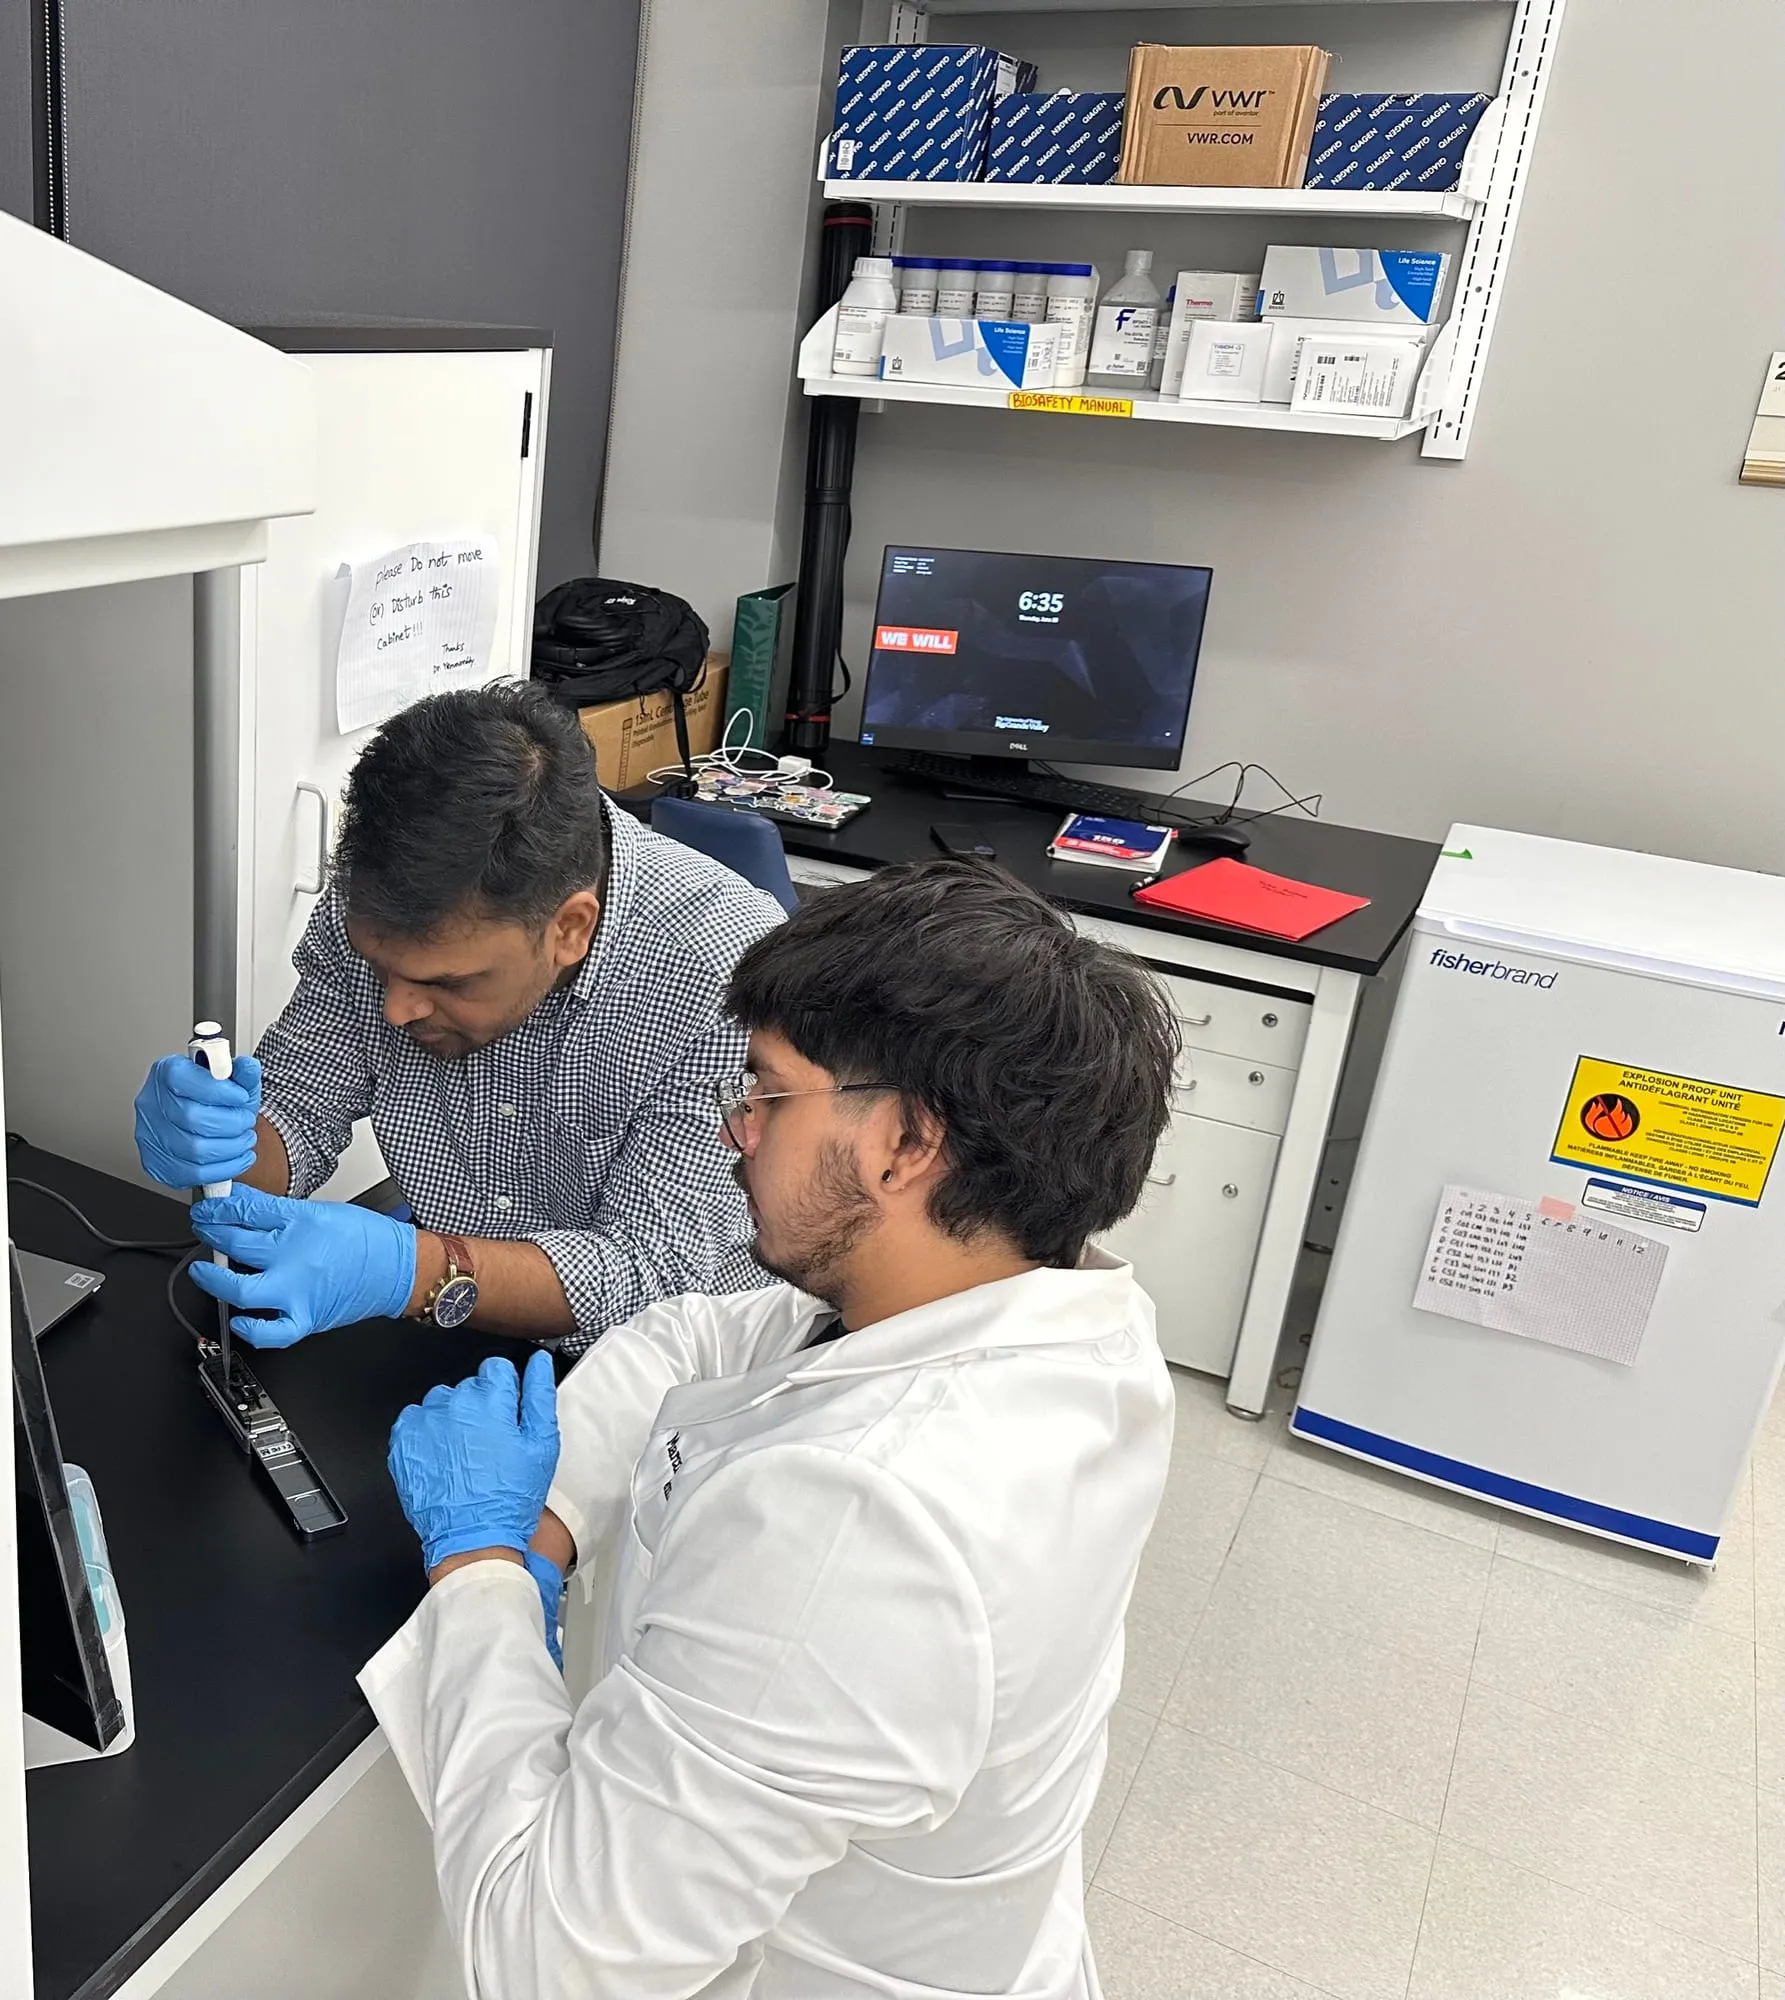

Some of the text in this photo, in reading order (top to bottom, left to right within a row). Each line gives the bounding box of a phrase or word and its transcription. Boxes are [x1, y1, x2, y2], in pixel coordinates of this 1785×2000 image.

[884, 48, 906, 71] QIAGEN
[926, 56, 949, 79] QIAGEN
[855, 61, 877, 83] QIAGEN
[898, 68, 920, 91] QIAGEN
[869, 80, 891, 103] QIAGEN
[912, 88, 935, 110] QIAGEN
[941, 76, 964, 99] QIAGEN
[842, 92, 863, 114] QIAGEN
[883, 100, 905, 122] QIAGEN
[1082, 100, 1106, 123] QIAGEN
[1422, 102, 1450, 127] QIAGEN
[856, 111, 877, 133] QIAGEN
[926, 107, 949, 130] QIAGEN
[1007, 104, 1030, 127] QIAGEN
[1051, 112, 1075, 136] QIAGEN
[1334, 107, 1361, 131] QIAGEN
[897, 119, 919, 141] QIAGEN
[941, 127, 964, 149] QIAGEN
[1022, 124, 1044, 147] QIAGEN
[1098, 120, 1122, 143] QIAGEN
[1187, 133, 1254, 144] VWR.COM
[1385, 116, 1413, 140] QIAGEN
[1438, 124, 1467, 148] QIAGEN
[870, 130, 891, 152] QIAGEN
[912, 139, 934, 161] QIAGEN
[992, 136, 1014, 158] QIAGEN
[1066, 132, 1090, 155] QIAGEN
[1350, 128, 1378, 152] QIAGEN
[1402, 137, 1430, 161] QIAGEN
[884, 150, 906, 171] QIAGEN
[1036, 144, 1060, 166] QIAGEN
[1082, 152, 1106, 174] QIAGEN
[1315, 141, 1342, 164] QIAGEN
[1366, 149, 1394, 173] QIAGEN
[926, 158, 949, 180] QIAGEN
[1007, 156, 1029, 178] QIAGEN
[1331, 162, 1358, 185] QIAGEN
[1418, 158, 1446, 182] QIAGEN
[1411, 257, 1436, 265] Science
[1013, 393, 1125, 413] BIOSAFETY MANUAL
[411, 556, 423, 572] Do
[428, 551, 453, 568] not
[458, 549, 483, 564] move
[429, 583, 453, 600] this
[1018, 591, 1064, 612] 6:35
[881, 631, 952, 649] WE WILL
[1430, 949, 1558, 989] fisherbrand
[1619, 1079, 1740, 1110] ANTIDÉFLAGRANT UNITÉ
[1623, 1070, 1742, 1101] EXPLOSION PROOF UNIT
[1588, 1143, 1628, 1155] FLAMMABLE
[1700, 1168, 1731, 1178] SMOKING
[1659, 1166, 1685, 1174] GARDER
[1621, 1187, 1648, 1197] NOTICE
[1653, 1194, 1670, 1202] AVIS
[1508, 1210, 1515, 1218] 4
[1525, 1213, 1532, 1221] 5
[1632, 1244, 1645, 1253] 12
